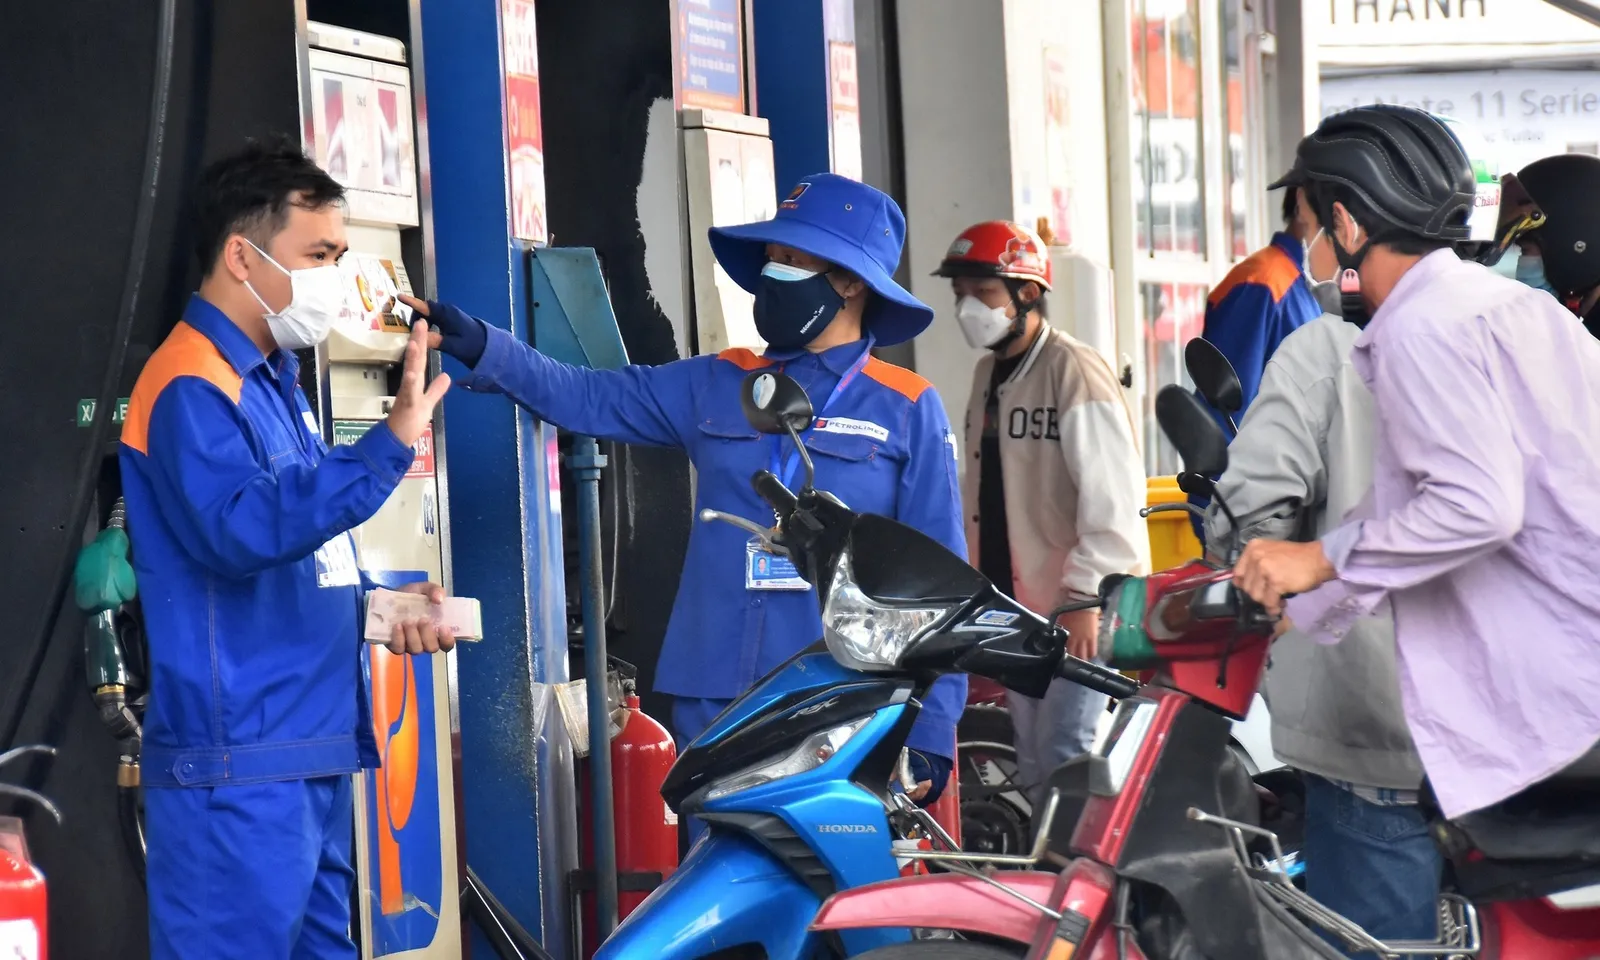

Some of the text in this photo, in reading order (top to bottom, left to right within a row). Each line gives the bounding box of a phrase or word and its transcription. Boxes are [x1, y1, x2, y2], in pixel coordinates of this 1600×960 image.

[1470, 90, 1506, 118] 11
[829, 421, 885, 436] PETROLIMEX
[423, 493, 435, 535] 03
[817, 824, 878, 833] HONDA
